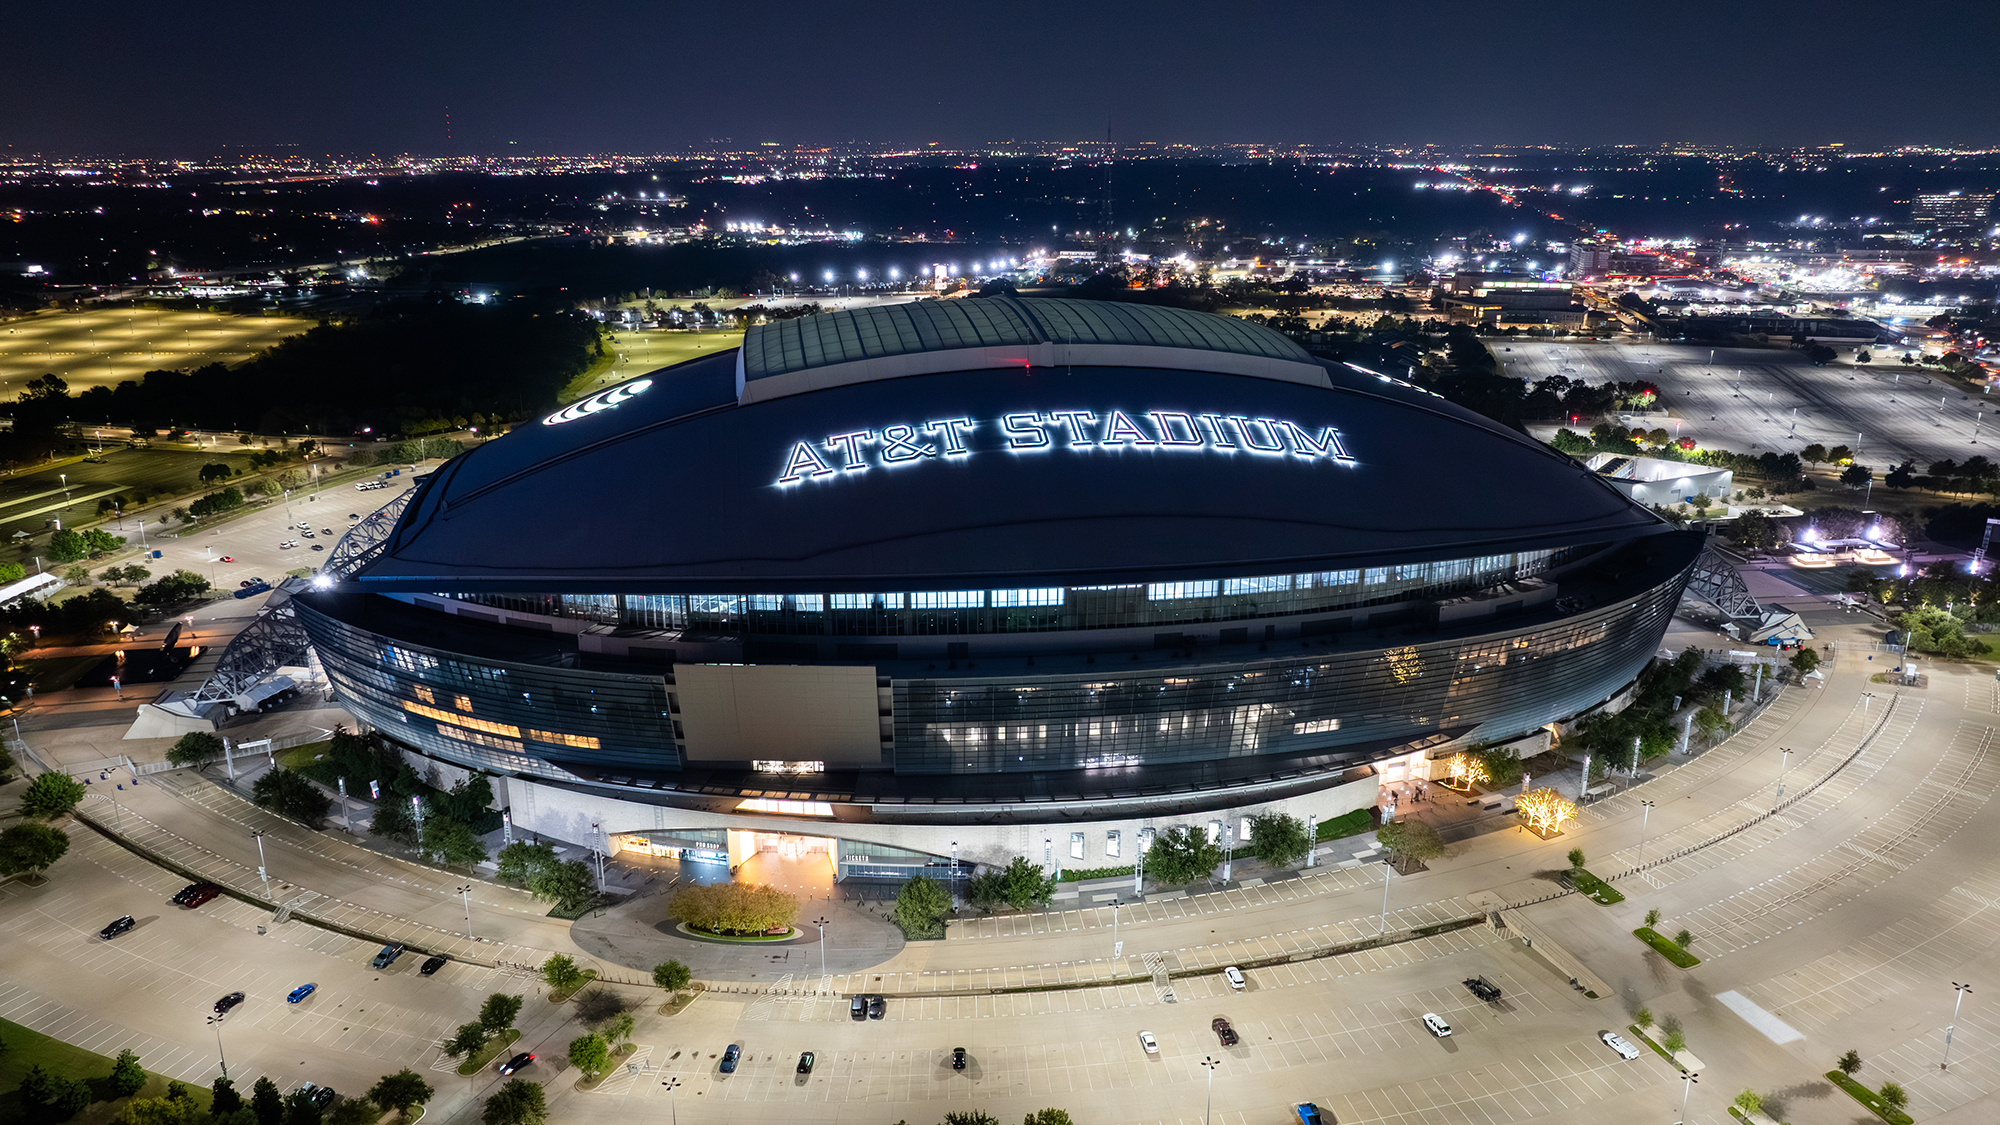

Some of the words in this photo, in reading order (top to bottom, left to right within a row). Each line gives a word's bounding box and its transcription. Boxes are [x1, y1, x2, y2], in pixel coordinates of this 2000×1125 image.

[779, 417, 972, 484] AT&T
[1002, 410, 1355, 461] STADIUM
[845, 854, 869, 862] TICKETS
